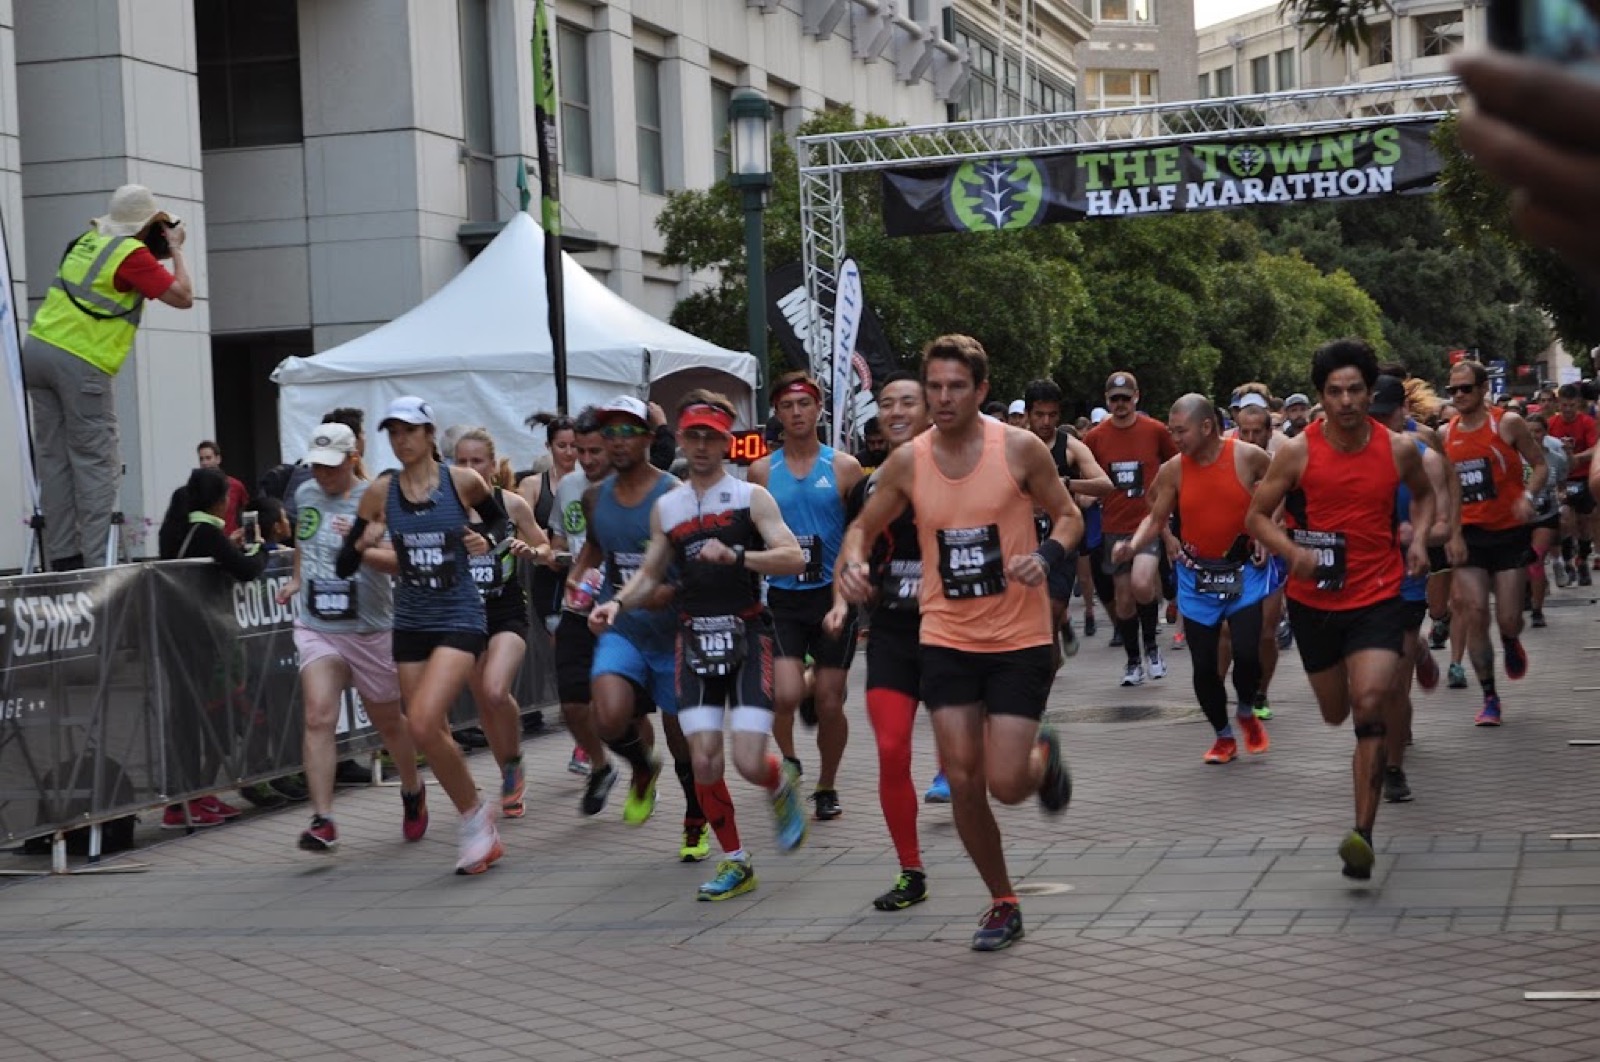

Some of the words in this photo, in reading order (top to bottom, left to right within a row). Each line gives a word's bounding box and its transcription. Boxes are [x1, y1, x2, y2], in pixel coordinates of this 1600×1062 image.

[1076, 147, 1181, 190] THE
[1086, 184, 1177, 215] HALF
[1186, 166, 1394, 207] MARATHON
[407, 547, 443, 566] 1475
[949, 545, 985, 570] 845
[13, 591, 95, 657] SERIES
